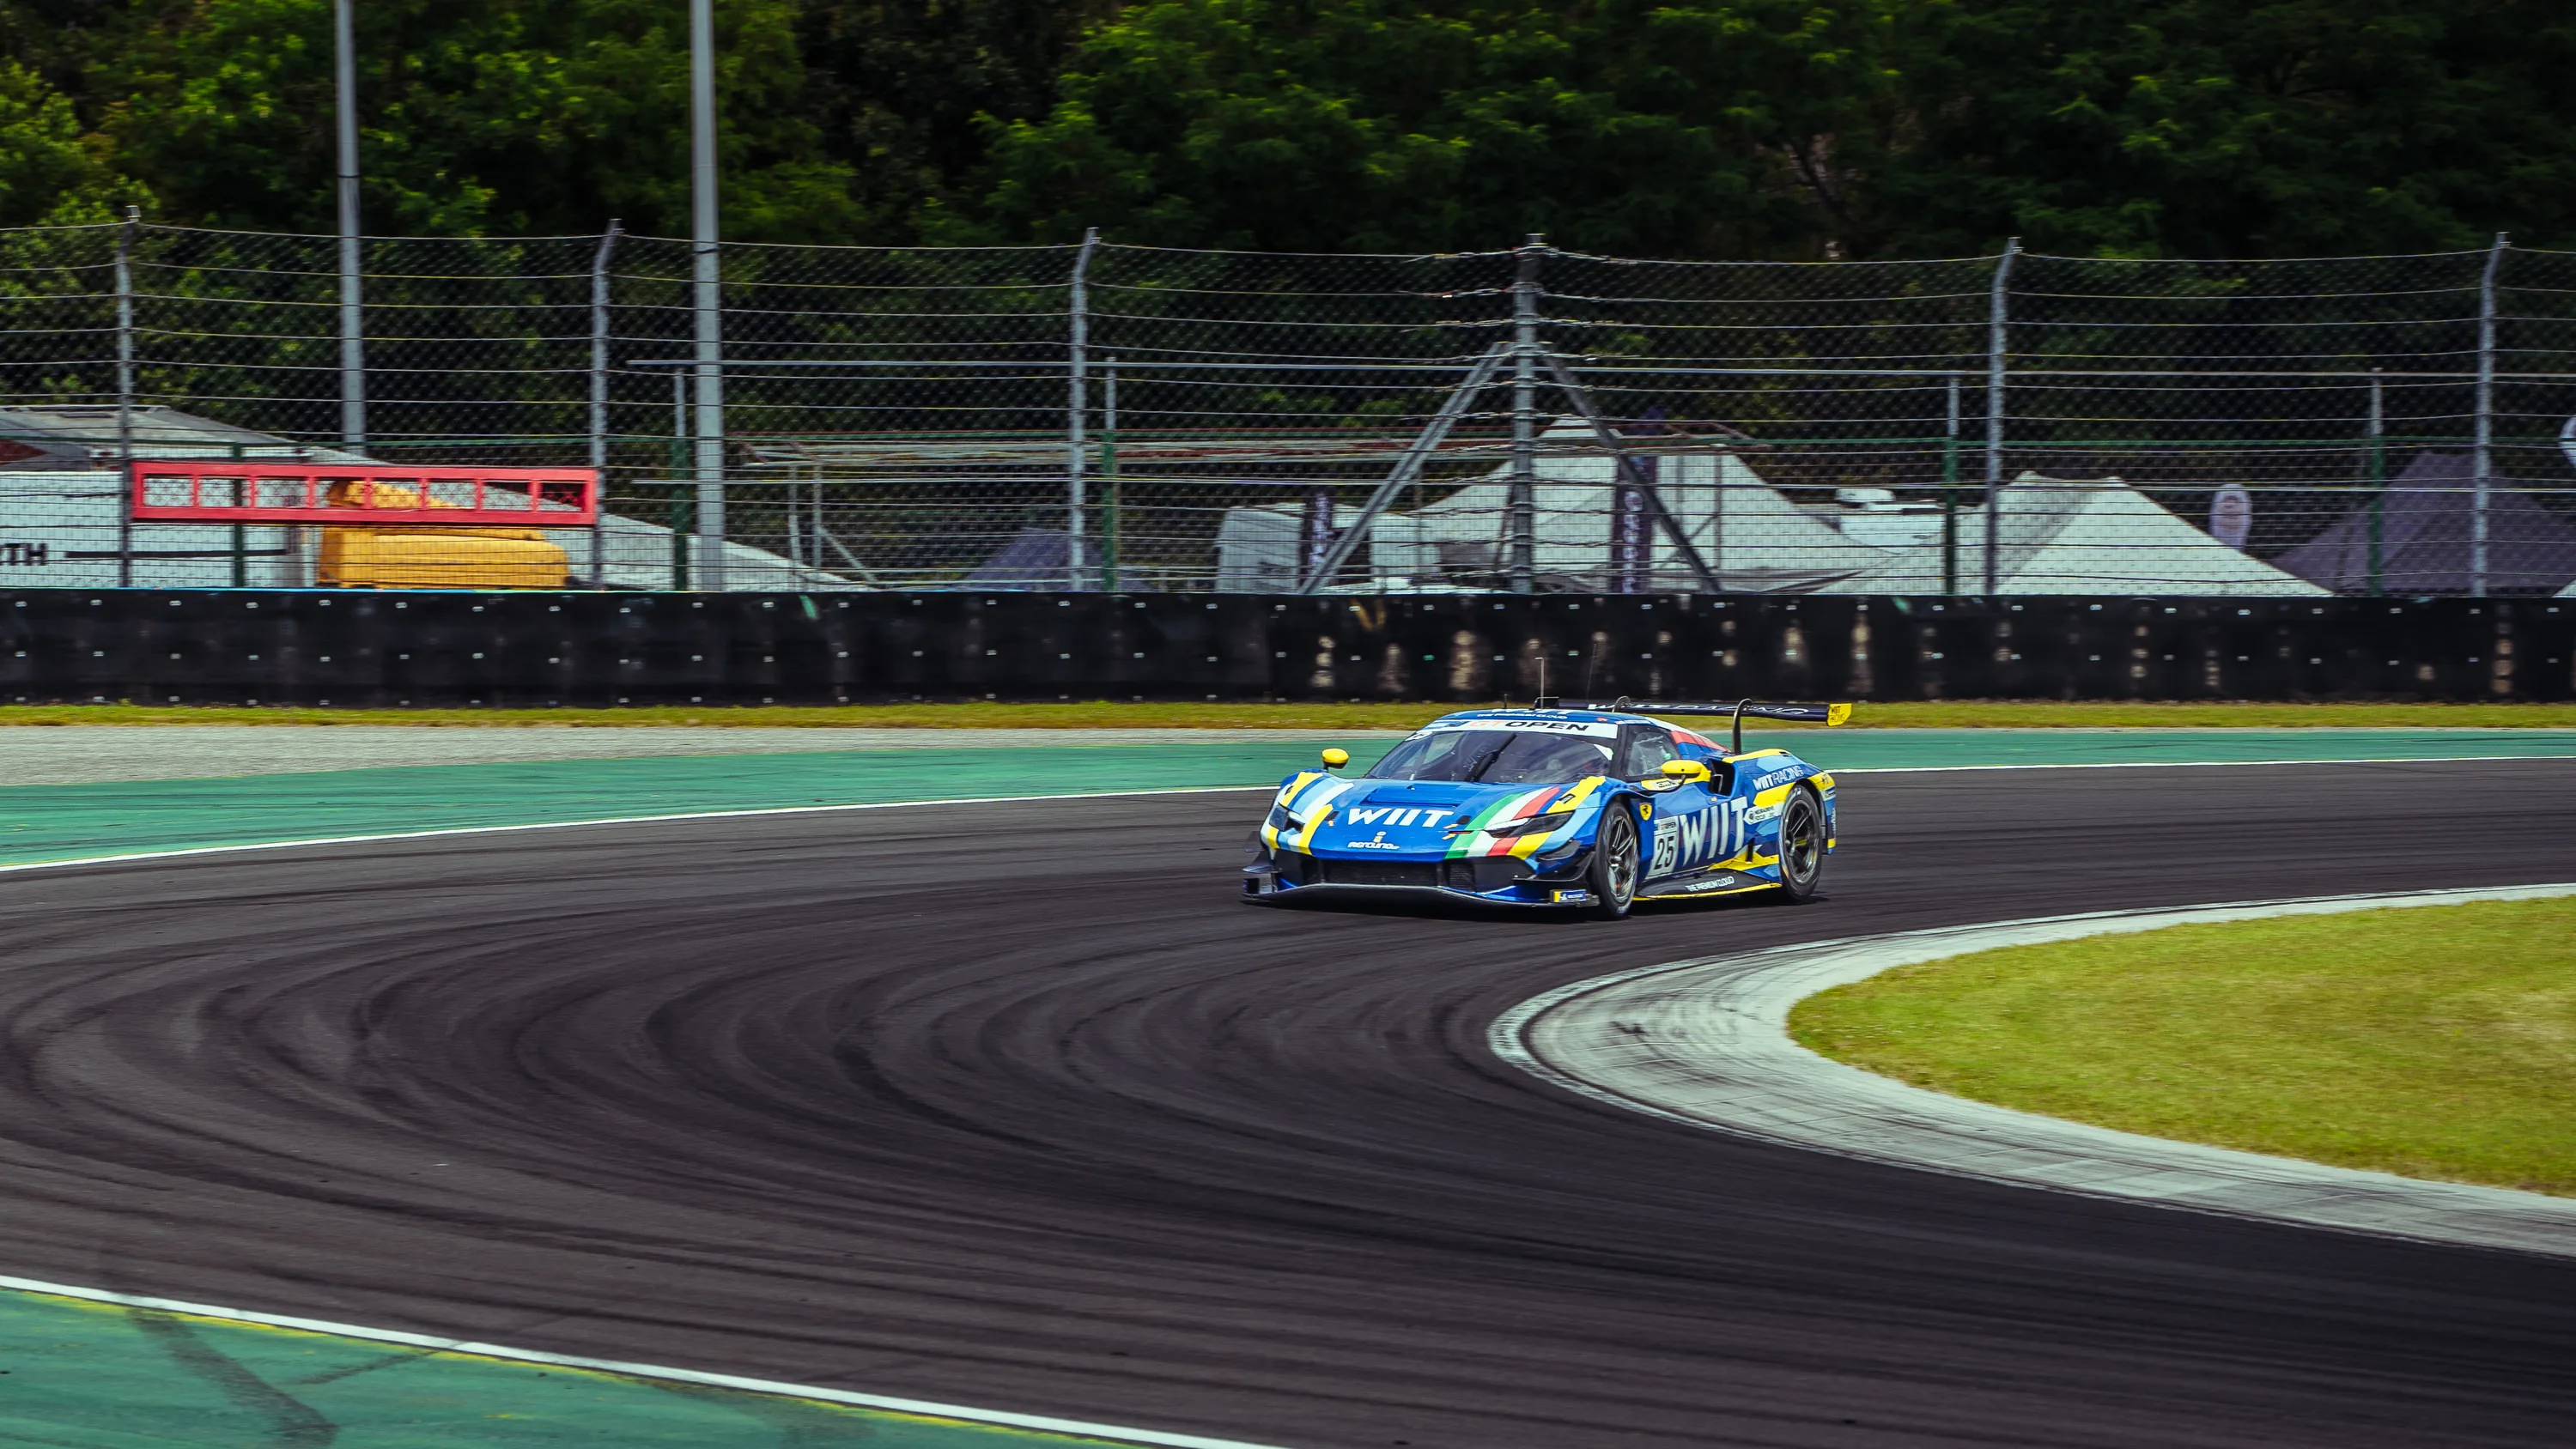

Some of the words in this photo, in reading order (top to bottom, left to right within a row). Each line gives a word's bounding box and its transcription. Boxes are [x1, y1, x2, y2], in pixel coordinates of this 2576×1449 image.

[1505, 721, 1589, 732] OPEN
[1347, 808, 1455, 828] WIIT
[1679, 796, 1748, 868] WIIT
[1654, 835, 1675, 871] 25
